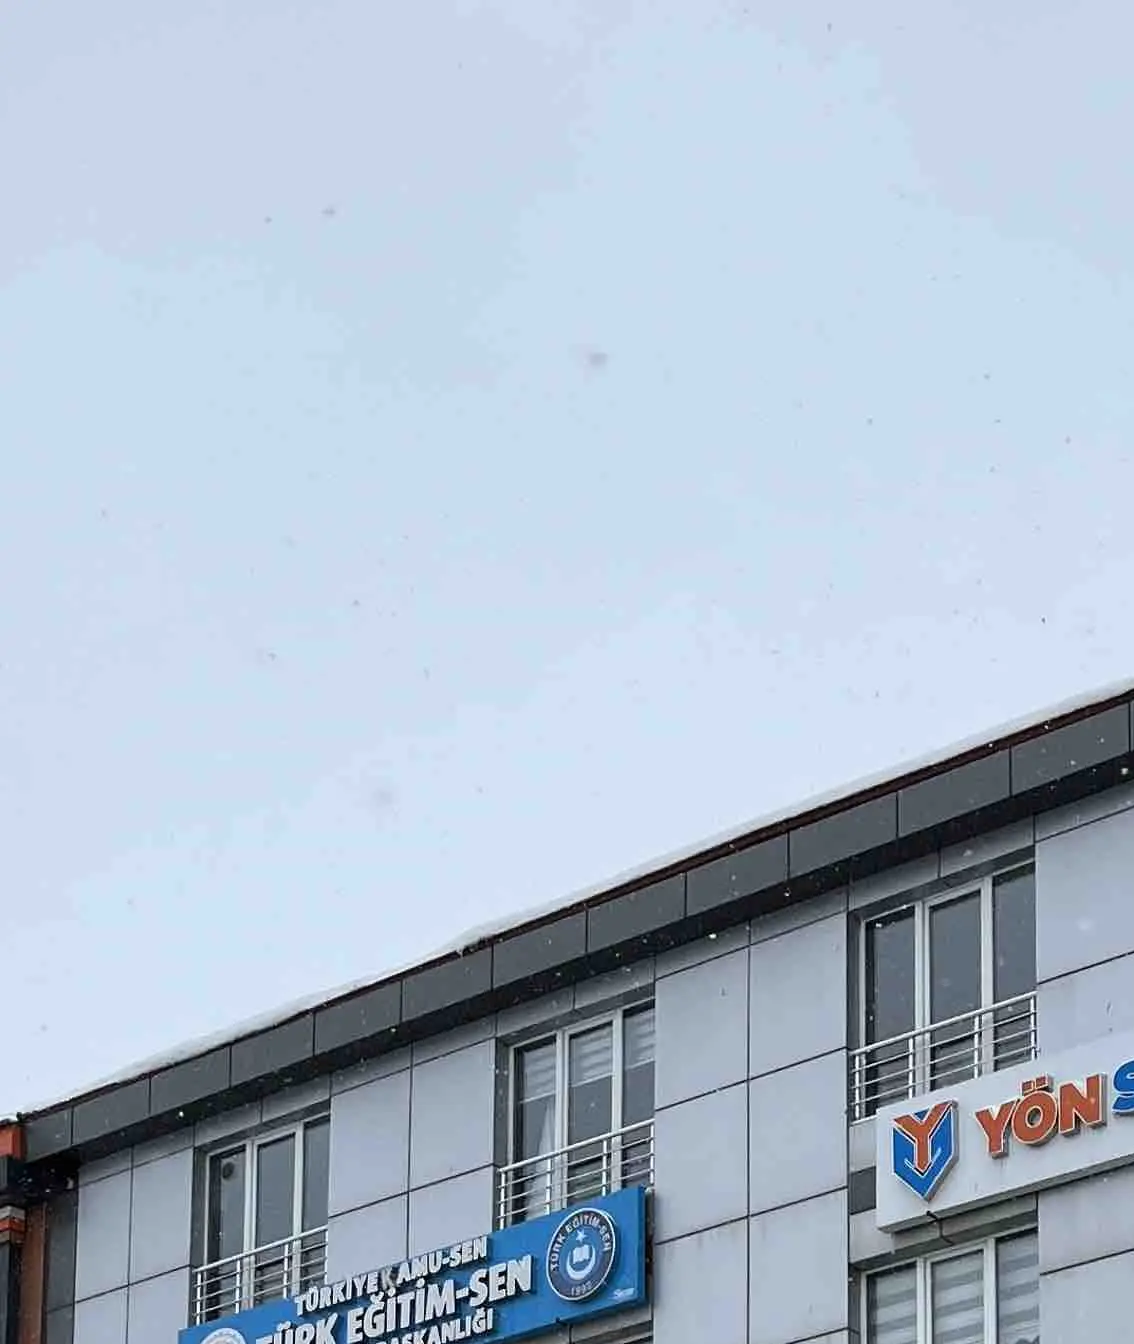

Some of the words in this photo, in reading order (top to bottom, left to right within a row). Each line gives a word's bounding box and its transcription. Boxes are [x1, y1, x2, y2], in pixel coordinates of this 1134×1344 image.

[973, 1073, 1106, 1158] YÖN
[347, 1254, 532, 1344] EĞİTİM-SEN
[381, 1235, 488, 1290] KAMU-SEN
